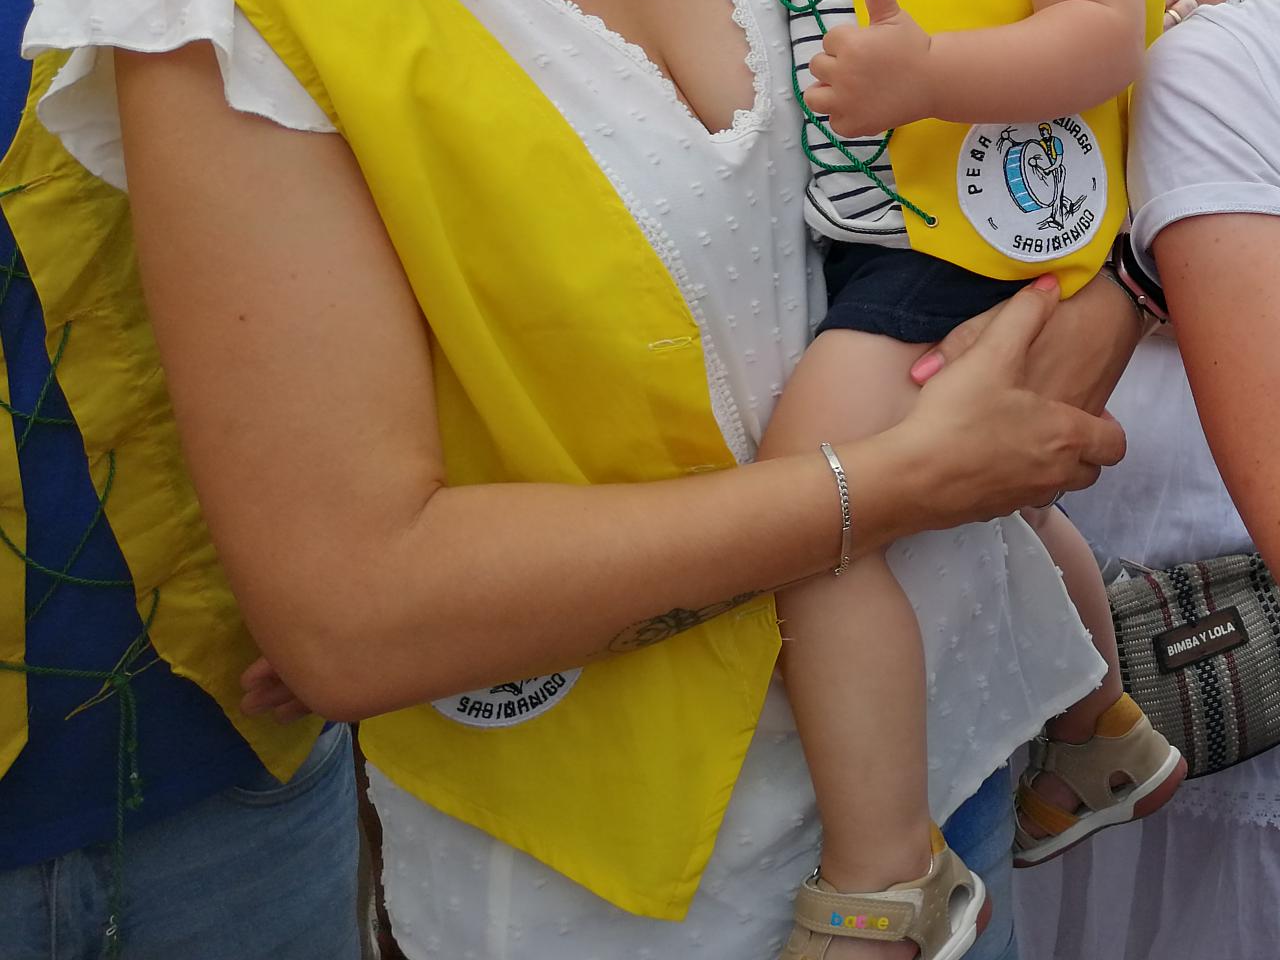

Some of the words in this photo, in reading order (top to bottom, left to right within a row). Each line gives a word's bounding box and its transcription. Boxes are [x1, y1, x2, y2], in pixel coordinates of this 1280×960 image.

[1167, 635, 1200, 657] BIMBA
[1199, 631, 1207, 643] Y
[1209, 621, 1236, 641] LOLA
